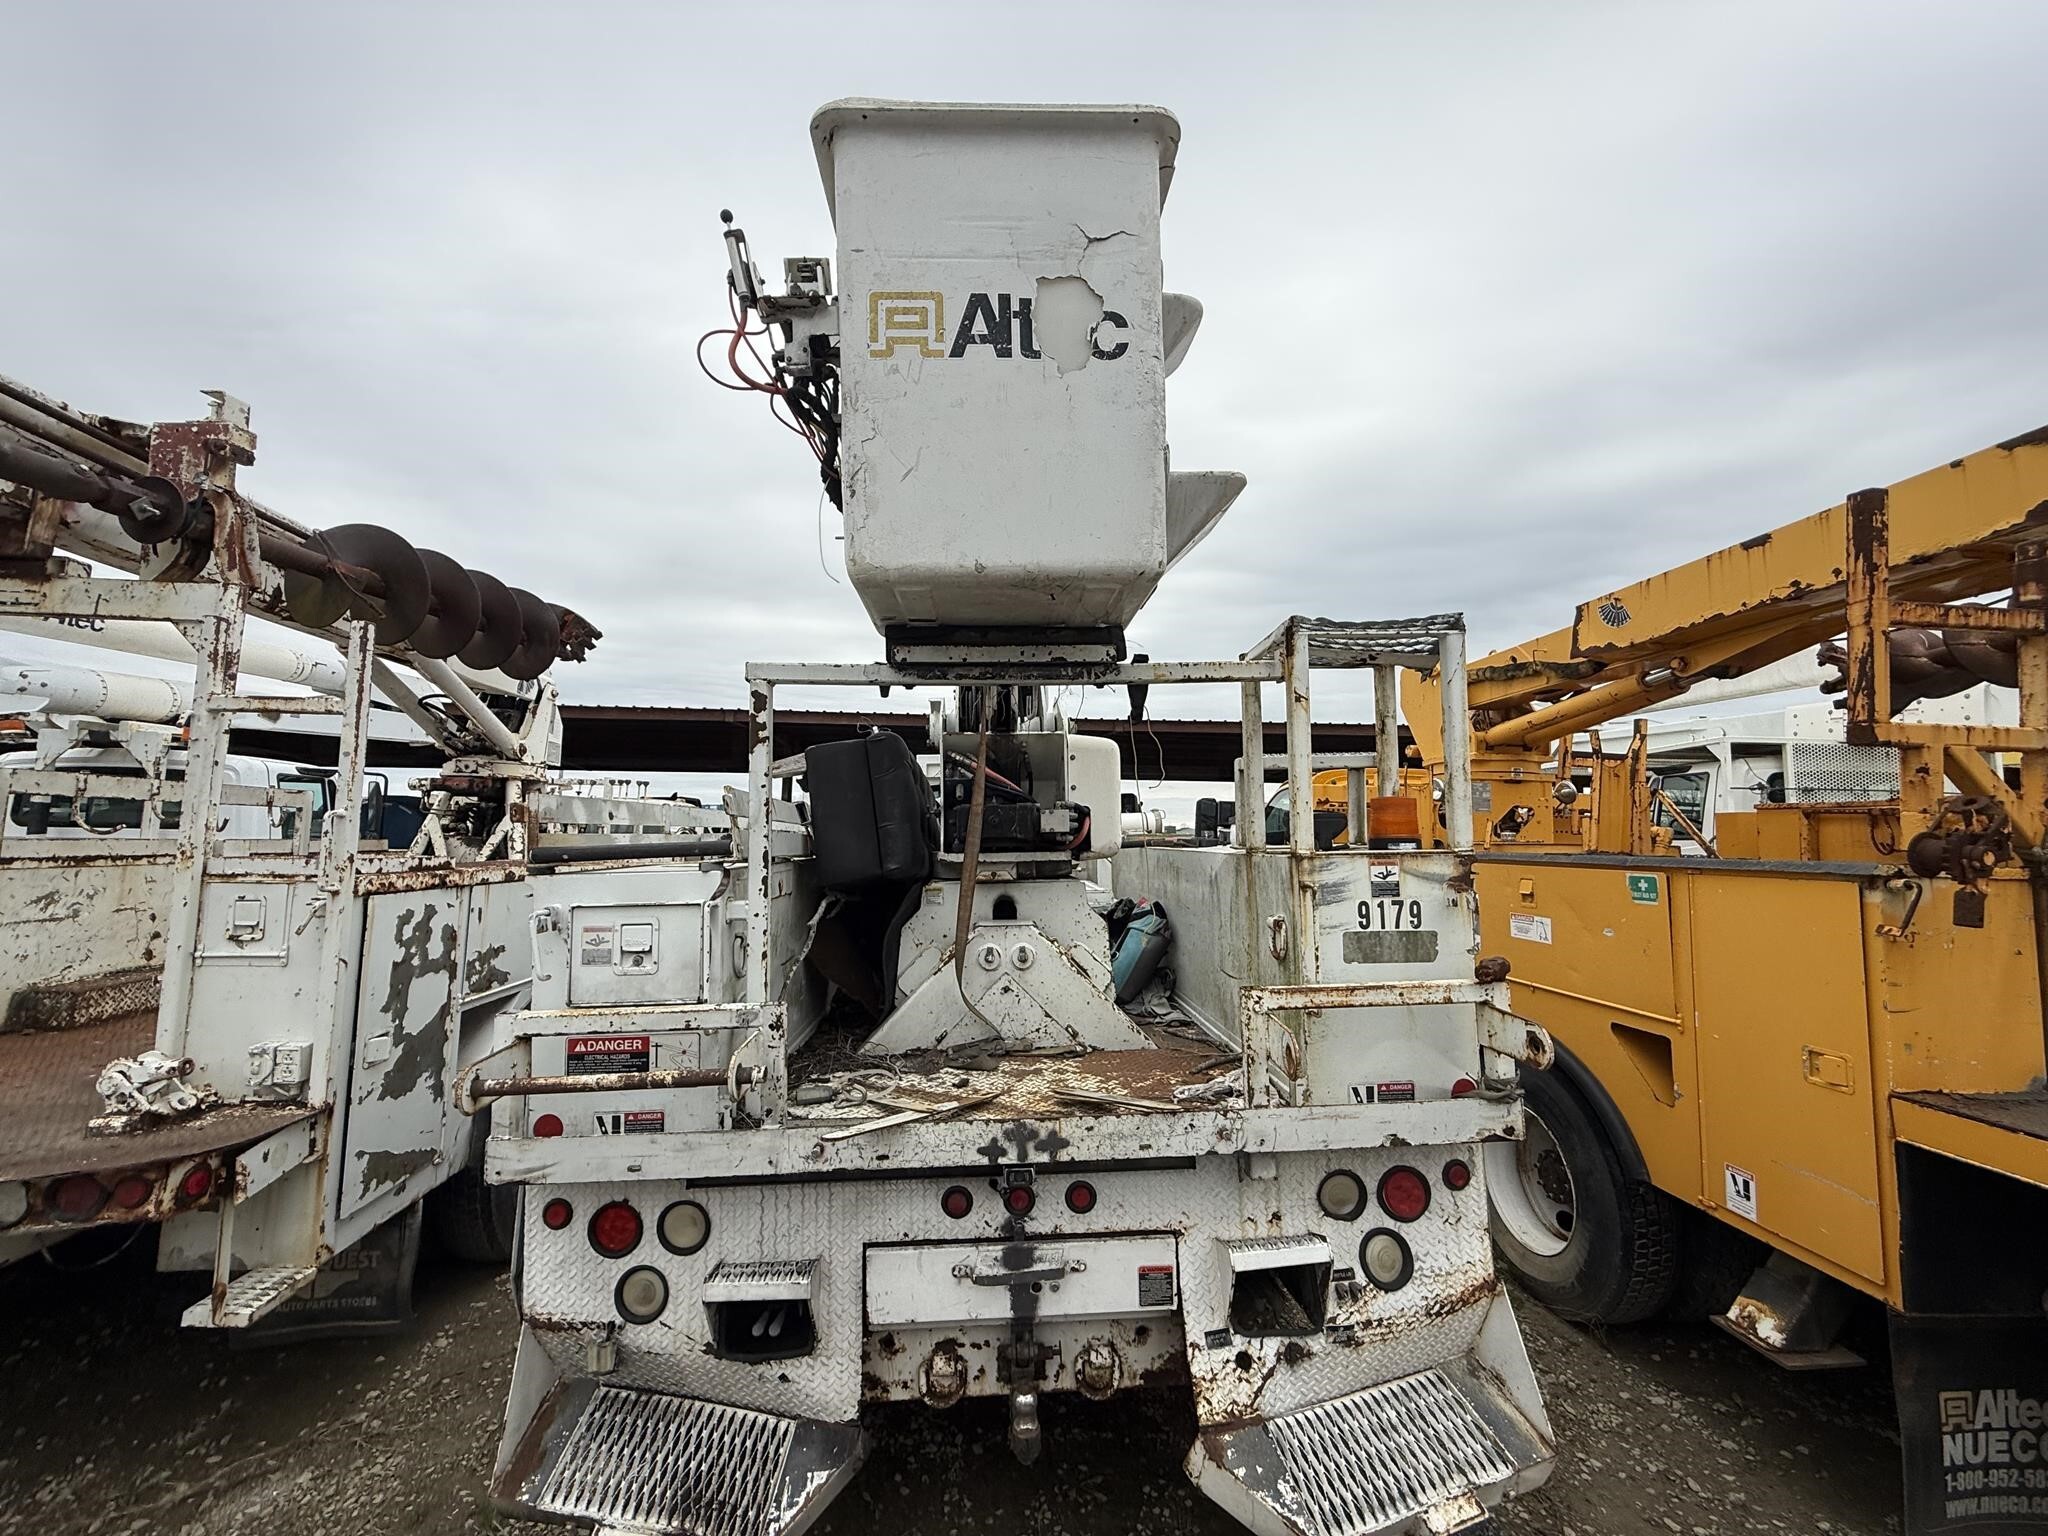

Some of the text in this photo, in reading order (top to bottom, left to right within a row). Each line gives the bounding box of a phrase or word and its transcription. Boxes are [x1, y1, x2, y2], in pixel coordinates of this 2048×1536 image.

[949, 292, 1129, 360] Altc
[1357, 900, 1422, 930] 9179
[587, 1040, 642, 1052] DANGER
[331, 1250, 380, 1271] UEST
[1974, 1389, 2048, 1430] Alte
[1944, 1468, 2048, 1493] 1-800-952-58
